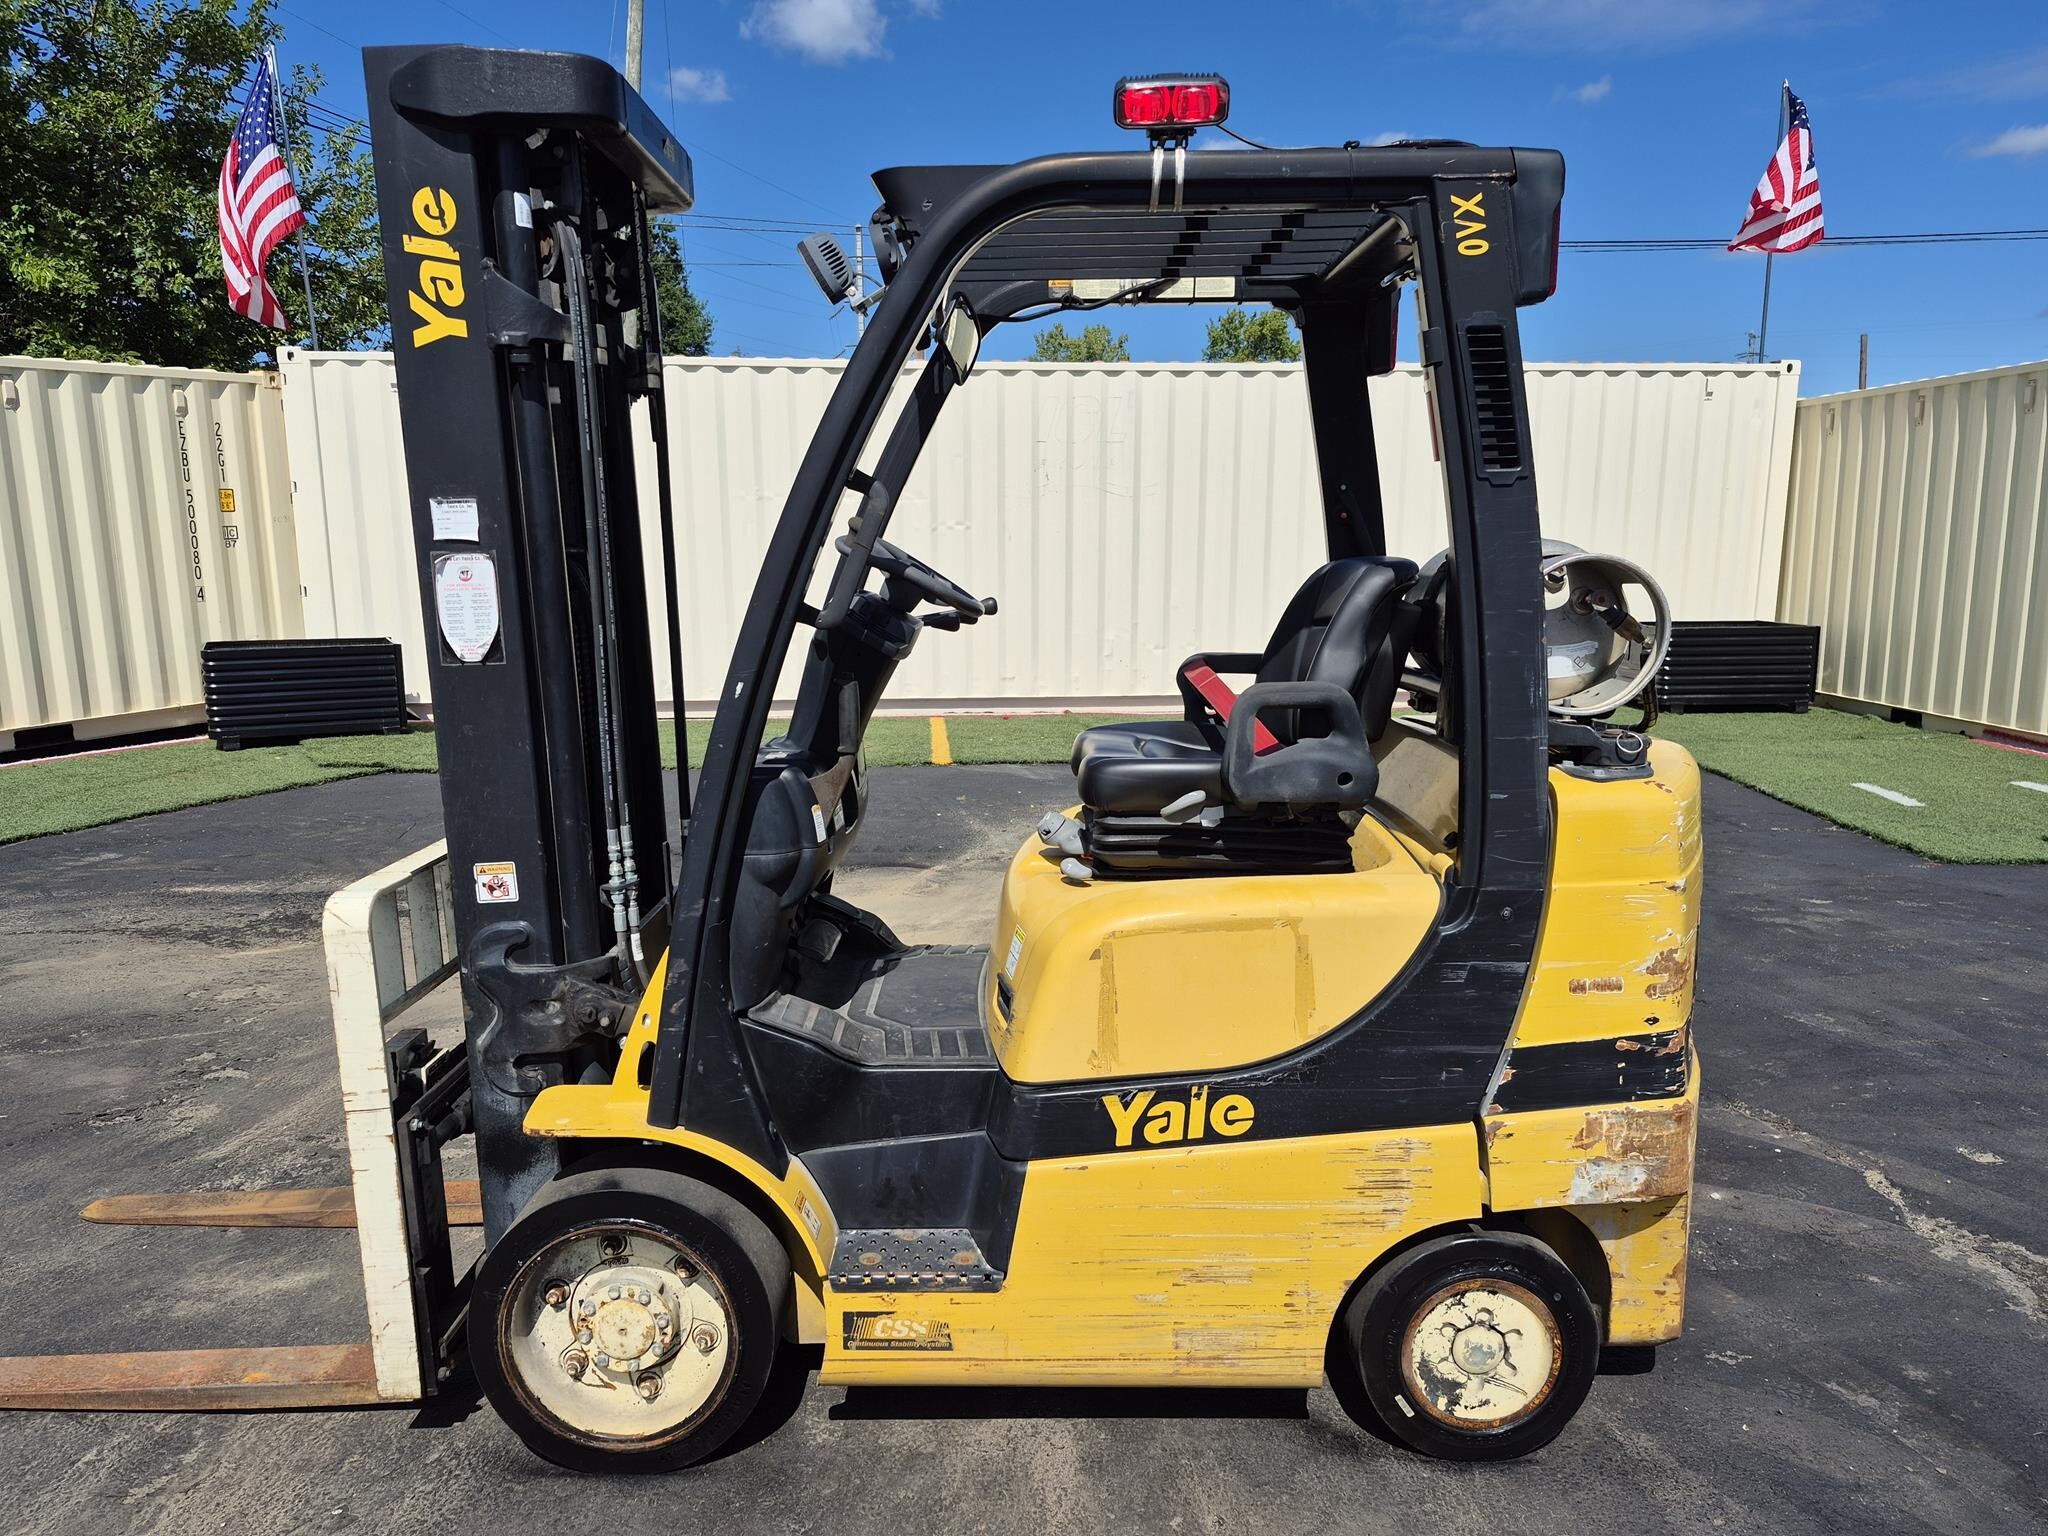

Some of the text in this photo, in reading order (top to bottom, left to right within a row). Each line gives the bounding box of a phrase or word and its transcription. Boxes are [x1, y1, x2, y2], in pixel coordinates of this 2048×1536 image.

[402, 186, 468, 348] Yale
[214, 422, 226, 482] 22G1
[178, 420, 205, 601] EZBU 500080 4
[225, 540, 236, 548] 87
[1102, 1085, 1255, 1147] Yale
[874, 1318, 930, 1338] CSS
[890, 1340, 920, 1348] Stability
